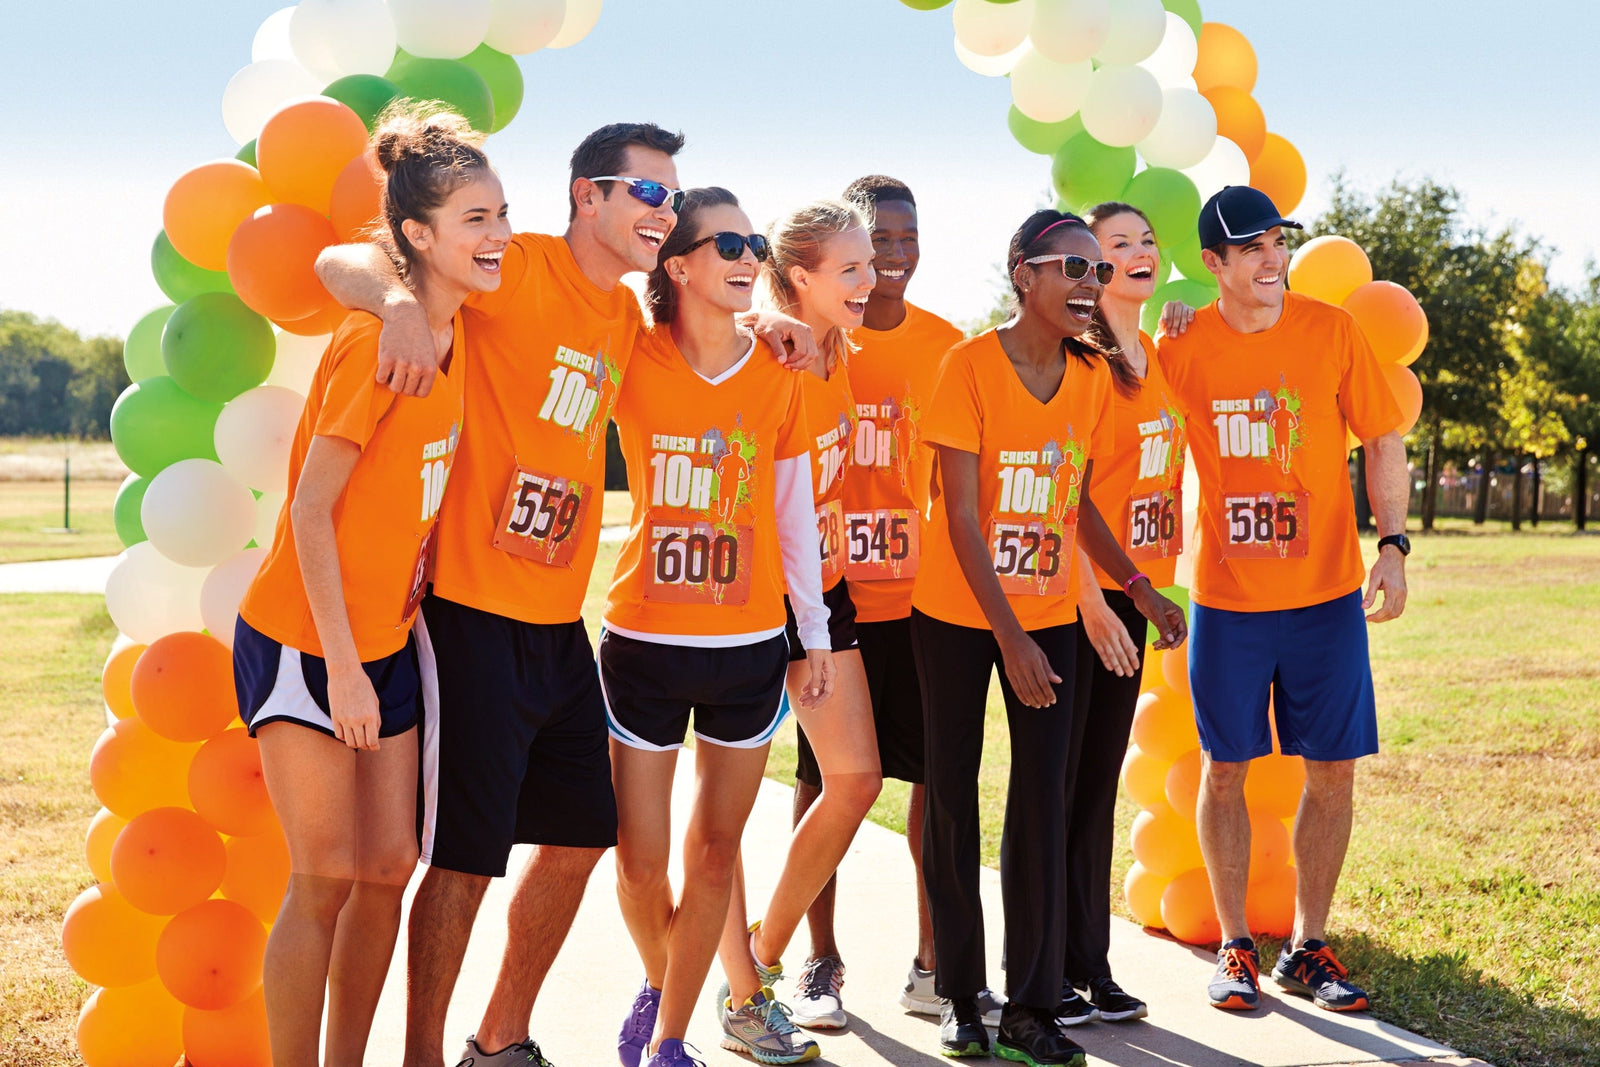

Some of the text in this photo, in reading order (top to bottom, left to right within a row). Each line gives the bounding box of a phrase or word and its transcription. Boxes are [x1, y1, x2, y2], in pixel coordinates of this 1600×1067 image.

[554, 345, 594, 373] CRUSH
[538, 365, 598, 433] 10K
[855, 404, 892, 418] USH IT
[1212, 398, 1267, 412] CRUSH IT
[422, 435, 455, 460] CRUSH IT
[652, 434, 717, 455] CRUSH IT
[816, 423, 847, 450] CRUSH IT
[1138, 417, 1170, 436] CRUSH IT
[1213, 414, 1269, 457] 10K
[818, 445, 847, 494] 10
[999, 450, 1055, 465] CRUSH IT
[420, 459, 451, 521] 10
[650, 452, 713, 509] 10K
[998, 466, 1051, 514] 10K
[509, 480, 580, 543] 559
[1132, 499, 1175, 546] 586
[1232, 502, 1297, 542] 585
[818, 512, 839, 560] 28
[850, 518, 909, 561] 545
[995, 530, 1061, 577] 523
[657, 532, 737, 584] 600
